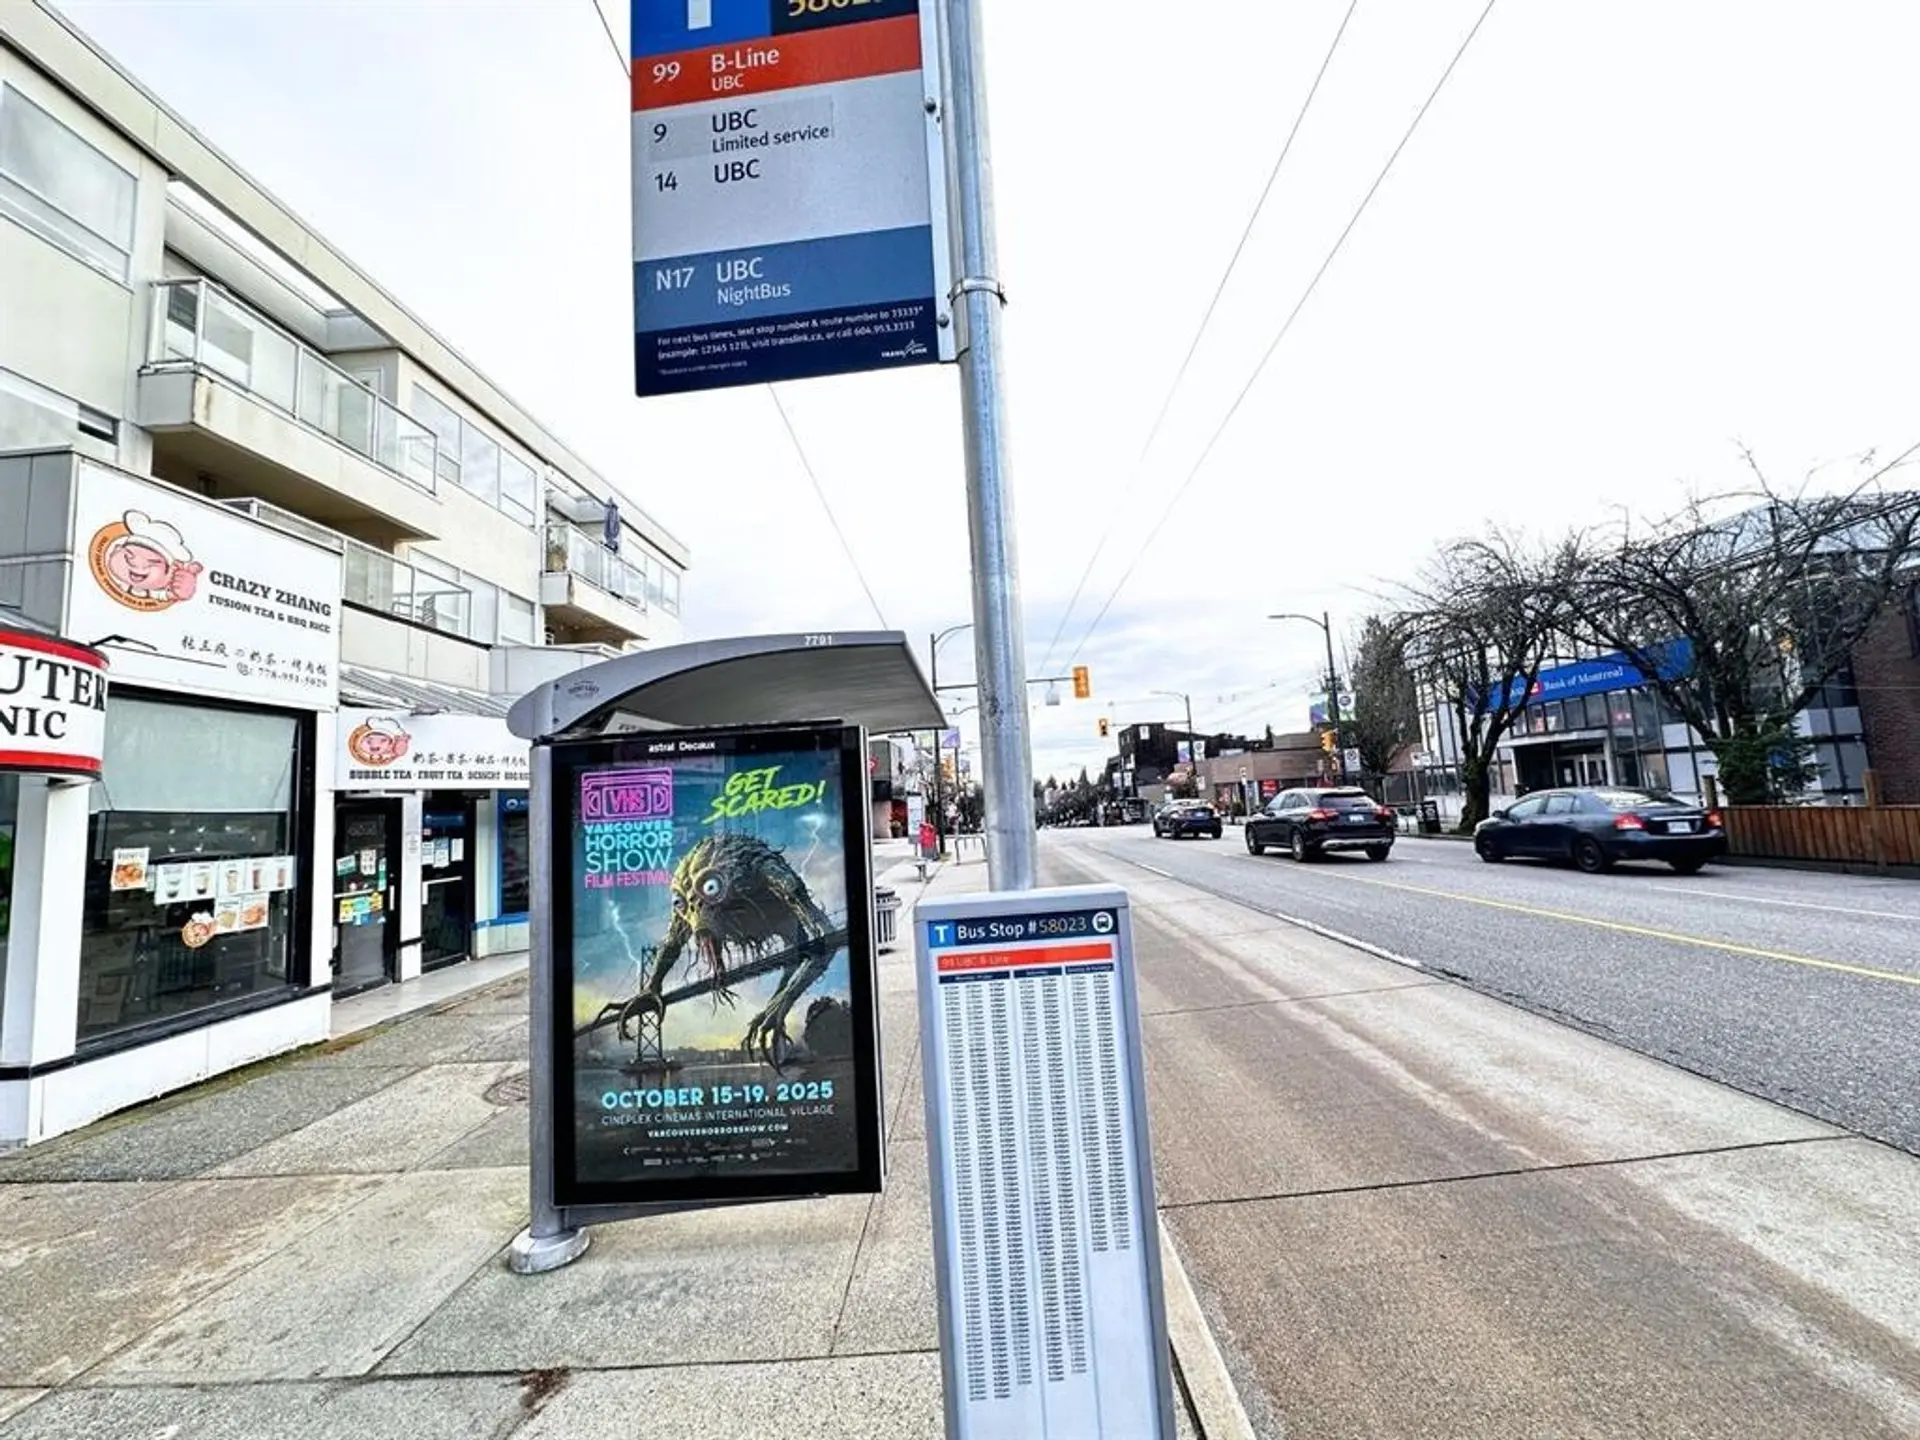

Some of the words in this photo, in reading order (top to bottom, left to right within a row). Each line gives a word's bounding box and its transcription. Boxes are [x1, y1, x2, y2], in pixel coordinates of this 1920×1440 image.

[652, 62, 681, 83] 99
[711, 48, 780, 73] B-Line
[711, 74, 744, 92] UBC
[653, 123, 668, 143] 9
[711, 109, 758, 133] UBC
[712, 129, 768, 153] Limited
[774, 125, 829, 145] service
[654, 171, 678, 192] 14
[714, 159, 760, 183] UBC
[656, 267, 694, 292] N17
[716, 257, 764, 283] UBC
[717, 283, 791, 306] NightBus
[657, 337, 671, 346] For
[672, 334, 691, 345] next
[692, 332, 708, 342] bus
[756, 325, 776, 335] stop
[777, 319, 810, 332] number
[811, 319, 819, 328] &
[845, 312, 878, 322] number
[880, 310, 890, 319] to
[752, 338, 770, 348] visit
[825, 332, 836, 340] or
[836, 328, 853, 338] call
[209, 570, 272, 599] CRAZY
[275, 589, 331, 616] ZHANG
[208, 594, 252, 613] FUSION
[254, 606, 275, 620] TEA
[287, 615, 307, 628] BBQ
[309, 620, 331, 634] RICE
[1543, 677, 1566, 690] Bank
[1567, 675, 1577, 686] of
[1578, 665, 1623, 683] Montreal
[648, 742, 675, 753] astral
[349, 770, 391, 780] BUBBLE
[393, 770, 412, 779] TEA
[418, 771, 444, 780] FRUIT
[447, 771, 463, 780] TEA
[725, 765, 783, 794] GET
[609, 788, 646, 813] VHS
[702, 780, 826, 825] SCARED!
[584, 820, 673, 834] VANCOUVER
[585, 831, 673, 852] HORROR
[585, 847, 673, 873] SHOW
[584, 873, 614, 888] FILM
[617, 870, 673, 887] FESTIVAL
[934, 925, 949, 943] T
[957, 924, 986, 940] Bus
[989, 920, 1025, 939] Stop
[601, 1087, 704, 1109] OCTOBER
[711, 1084, 770, 1105] 15-19,
[776, 1081, 834, 1101] 2025
[601, 1113, 651, 1126] CINEPLEX
[655, 1110, 701, 1124] CINEMAS
[704, 1107, 786, 1121] INTERNATIONAL
[790, 1103, 834, 1116] VILLAGE
[648, 1123, 789, 1138] VANCOUVERHORRORSHOW.COM
